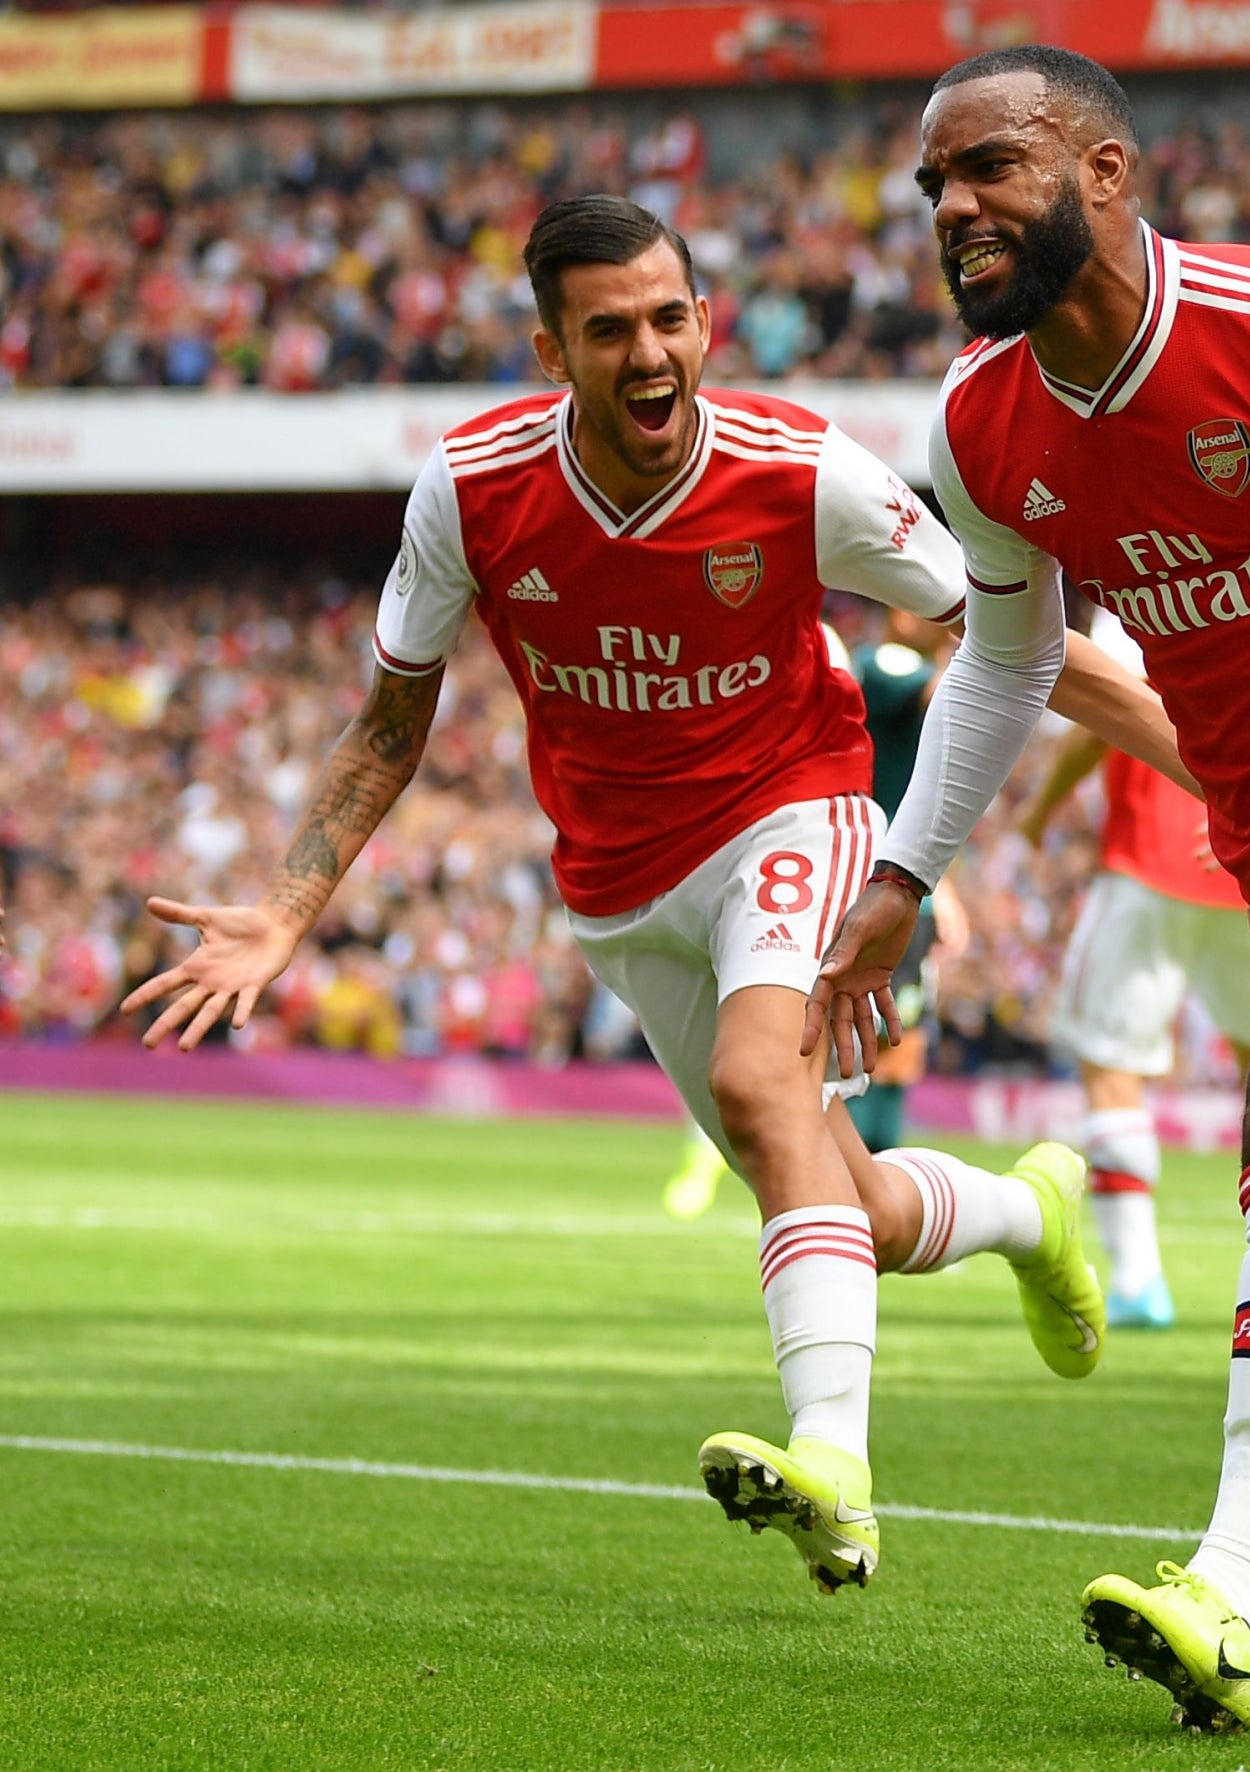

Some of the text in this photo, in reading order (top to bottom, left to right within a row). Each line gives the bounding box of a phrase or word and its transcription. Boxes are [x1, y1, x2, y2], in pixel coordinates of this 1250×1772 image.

[1195, 430, 1240, 450] Arsenal
[1023, 498, 1066, 521] adidas
[711, 552, 754, 566] Arsenal
[1116, 530, 1213, 576] Fly
[507, 587, 559, 602] adidas
[597, 626, 680, 666] Fly
[757, 850, 813, 915] 8
[750, 940, 800, 953] adidas
